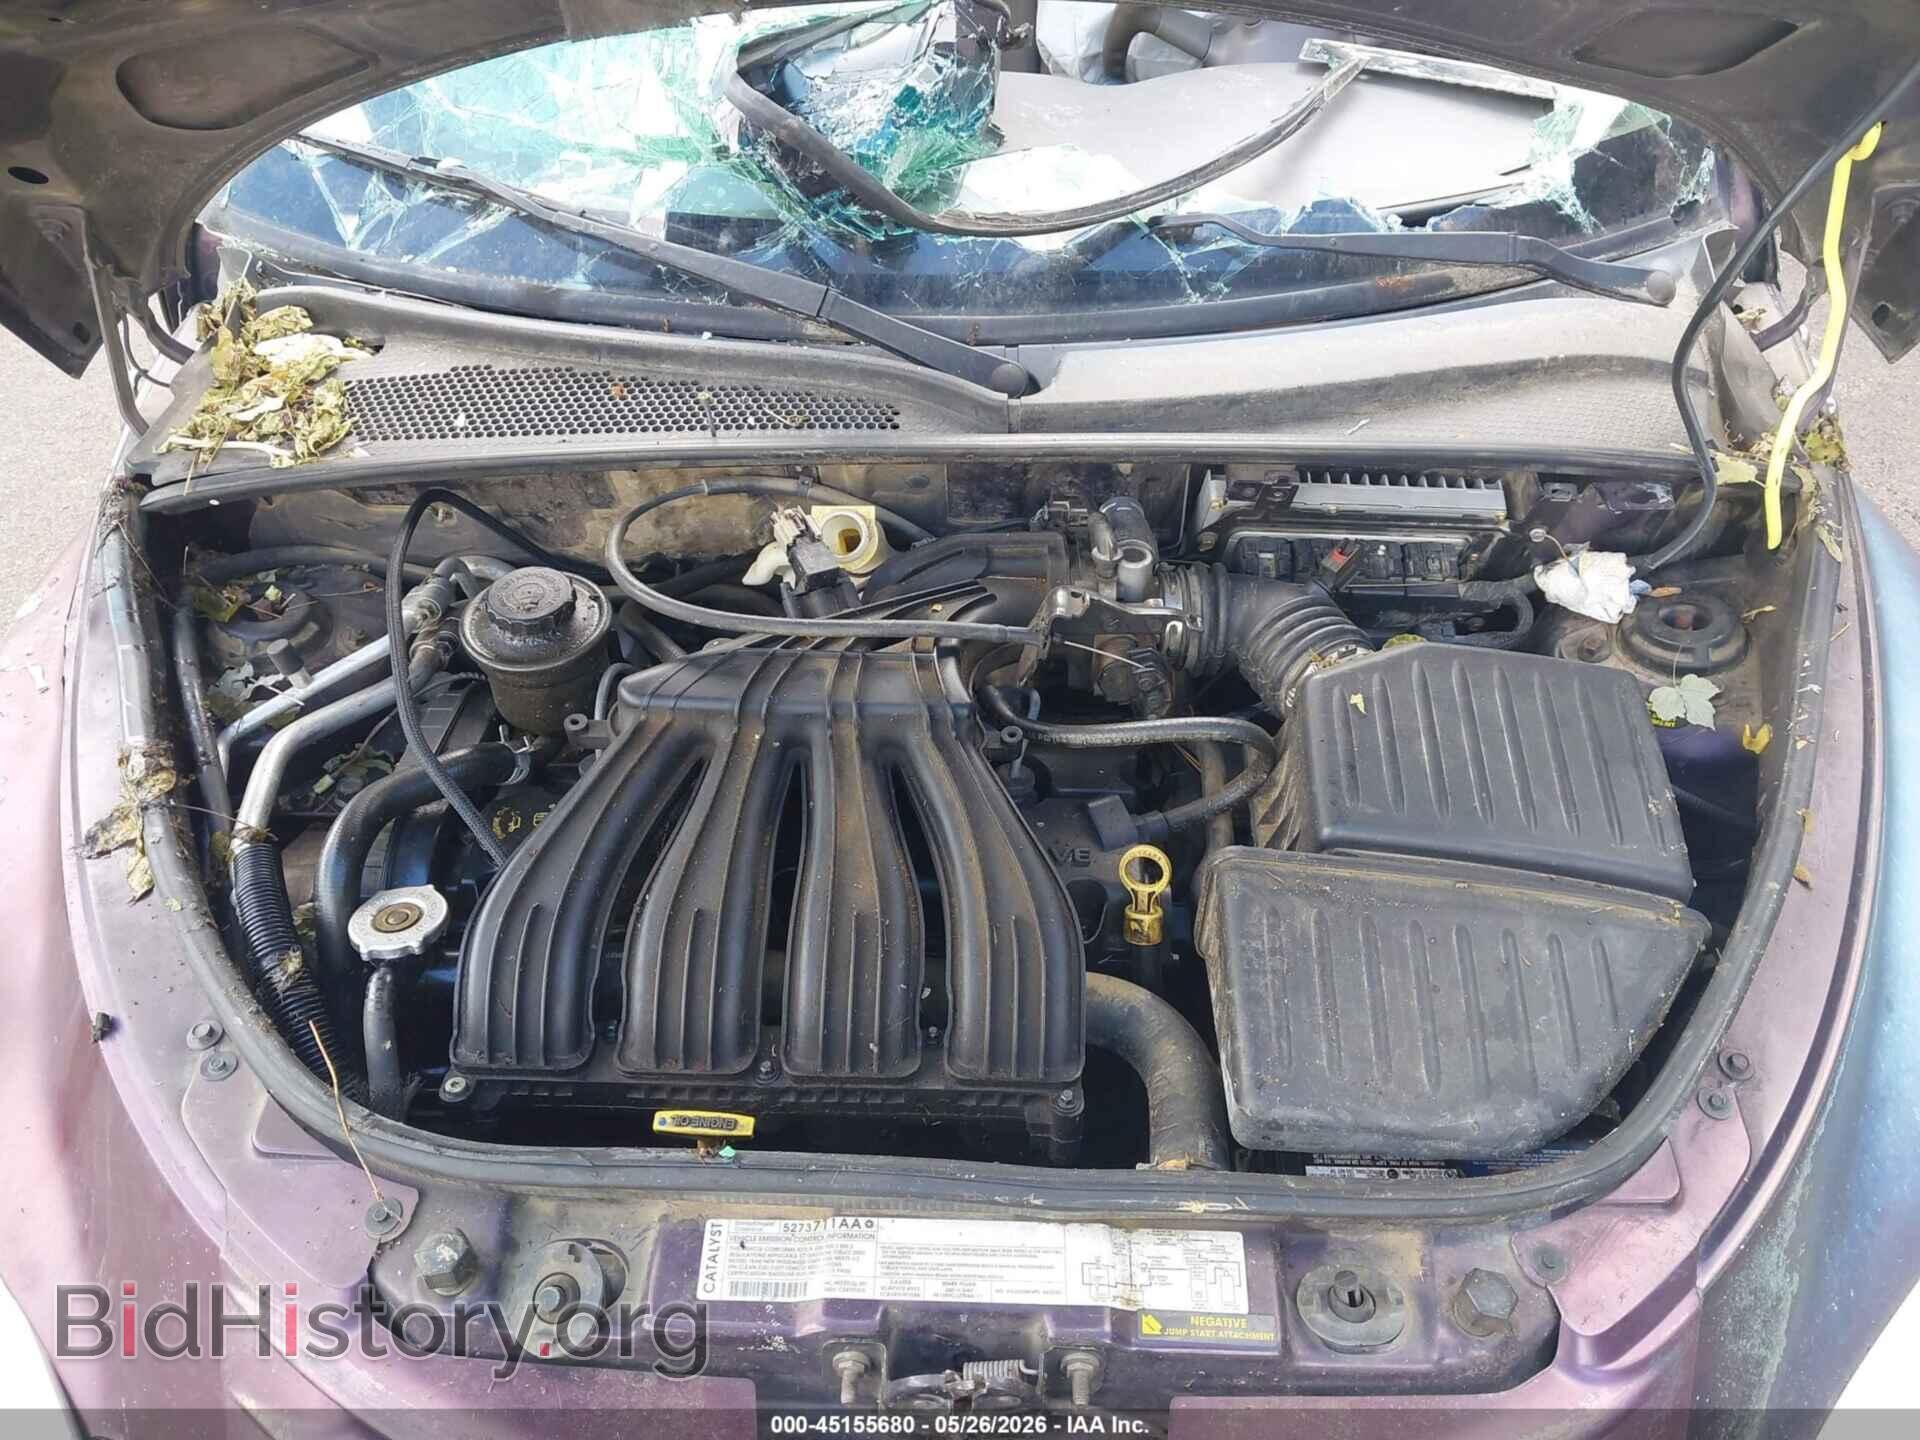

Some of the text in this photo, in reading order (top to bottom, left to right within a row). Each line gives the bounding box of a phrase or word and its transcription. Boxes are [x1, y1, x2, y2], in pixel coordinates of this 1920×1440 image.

[671, 1113, 736, 1130] ENGINE OIL
[704, 1222, 723, 1294] CATALYST
[1190, 1315, 1249, 1329] NEGATIVE
[1164, 1327, 1275, 1341] JUMP START ATTACHMENT
